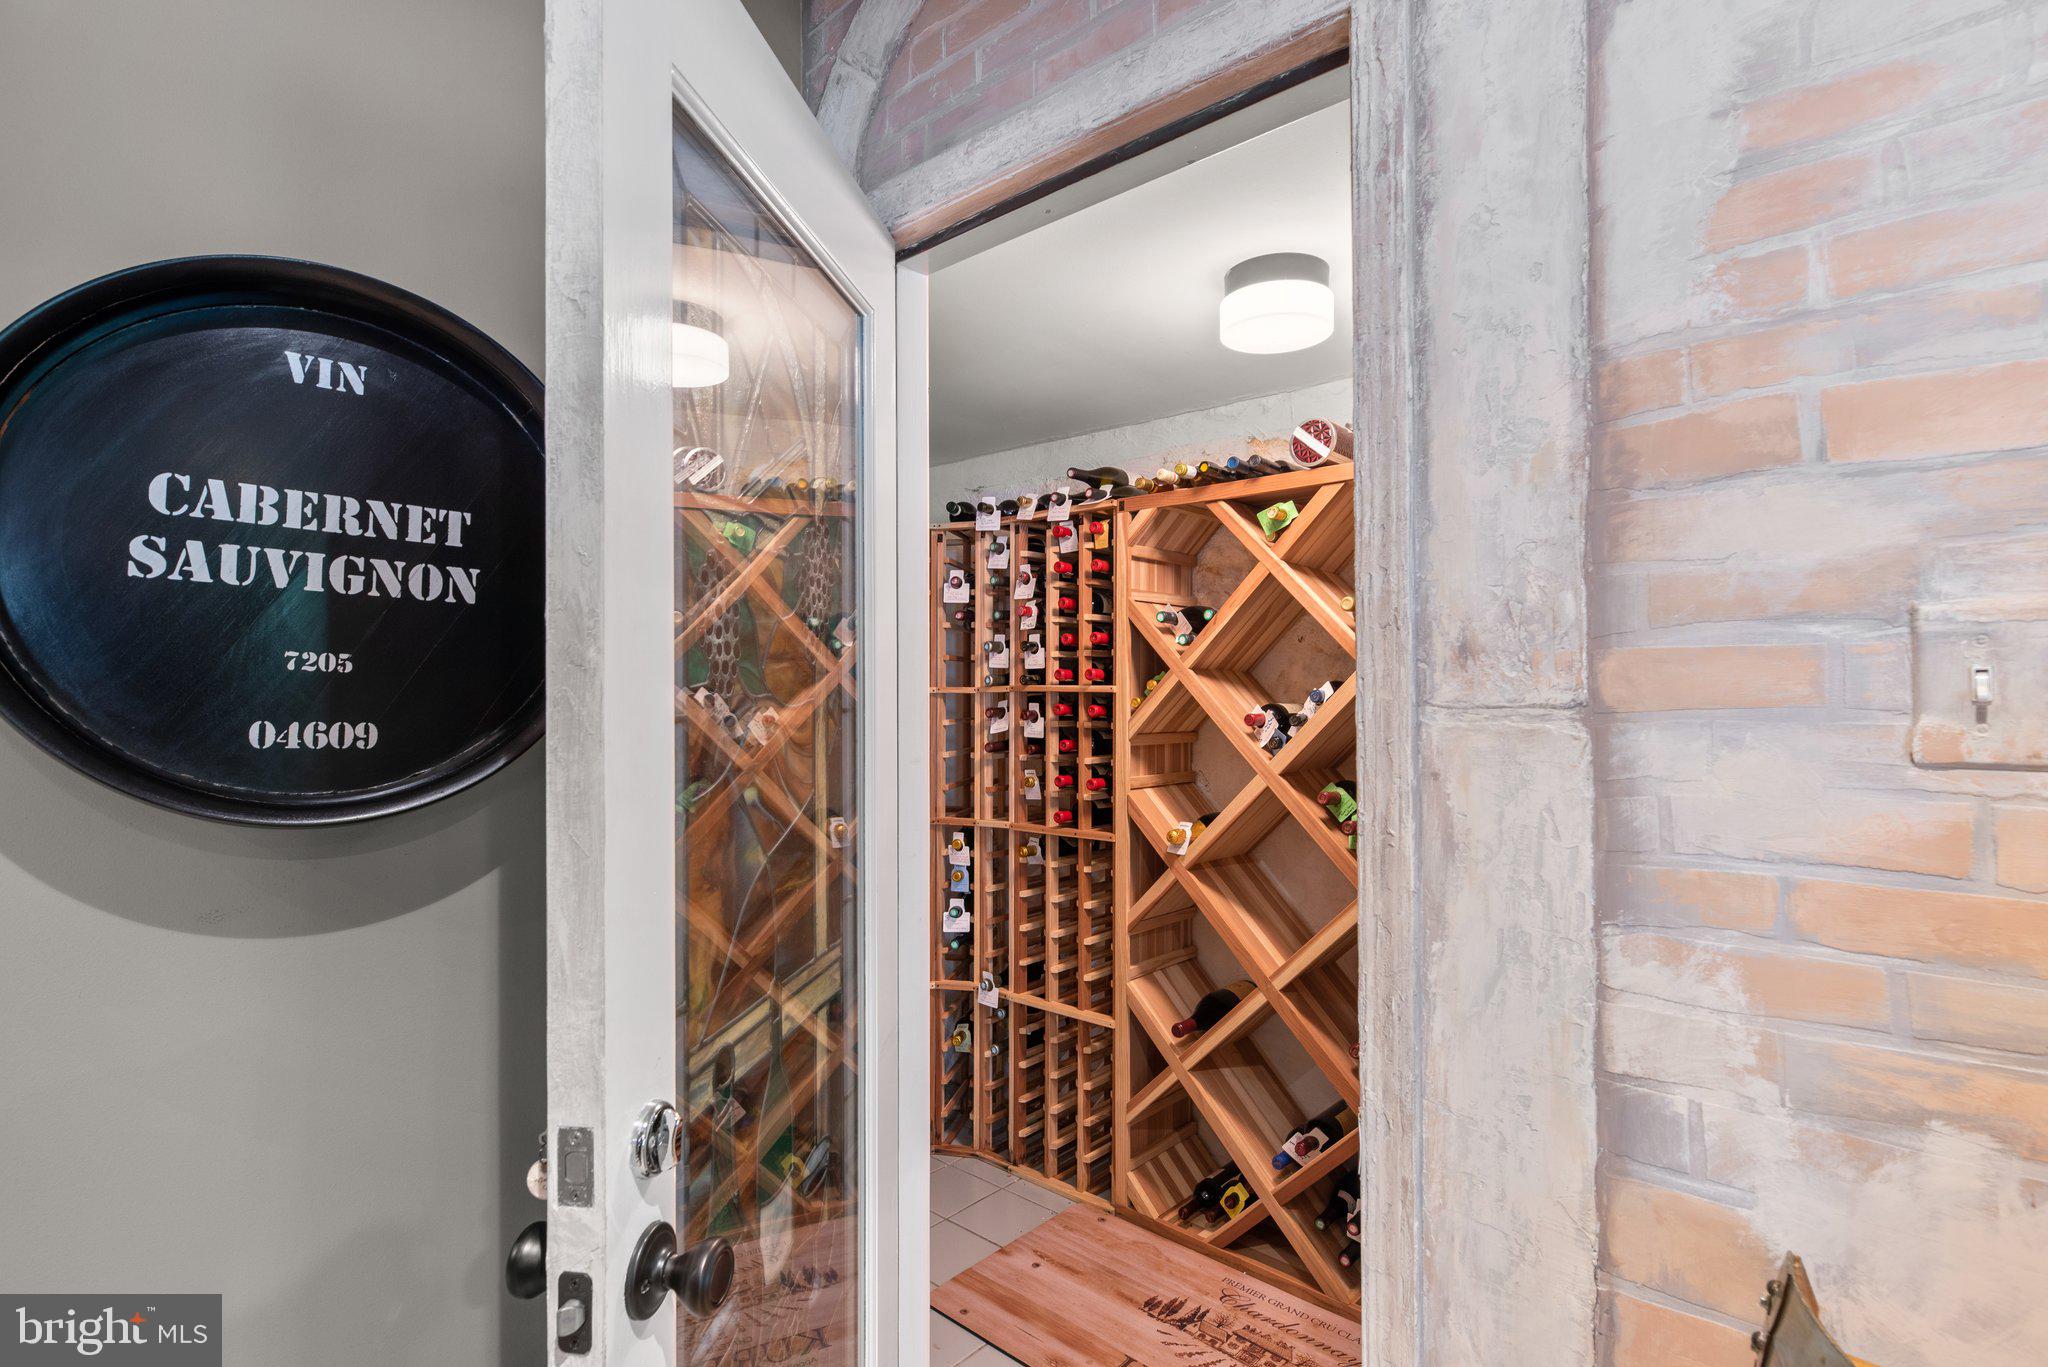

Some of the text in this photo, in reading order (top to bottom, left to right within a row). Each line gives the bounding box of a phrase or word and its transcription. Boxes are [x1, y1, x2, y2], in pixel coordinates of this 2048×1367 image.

[284, 351, 368, 395] VIN
[148, 472, 472, 548] CABERNET
[128, 534, 481, 604] SAUVIGNON
[284, 651, 353, 673] 7205
[249, 721, 379, 749] 04609
[1221, 1277, 1267, 1300] PREMIER
[1267, 1298, 1310, 1320] GRAND
[1310, 1317, 1336, 1332] CRU
